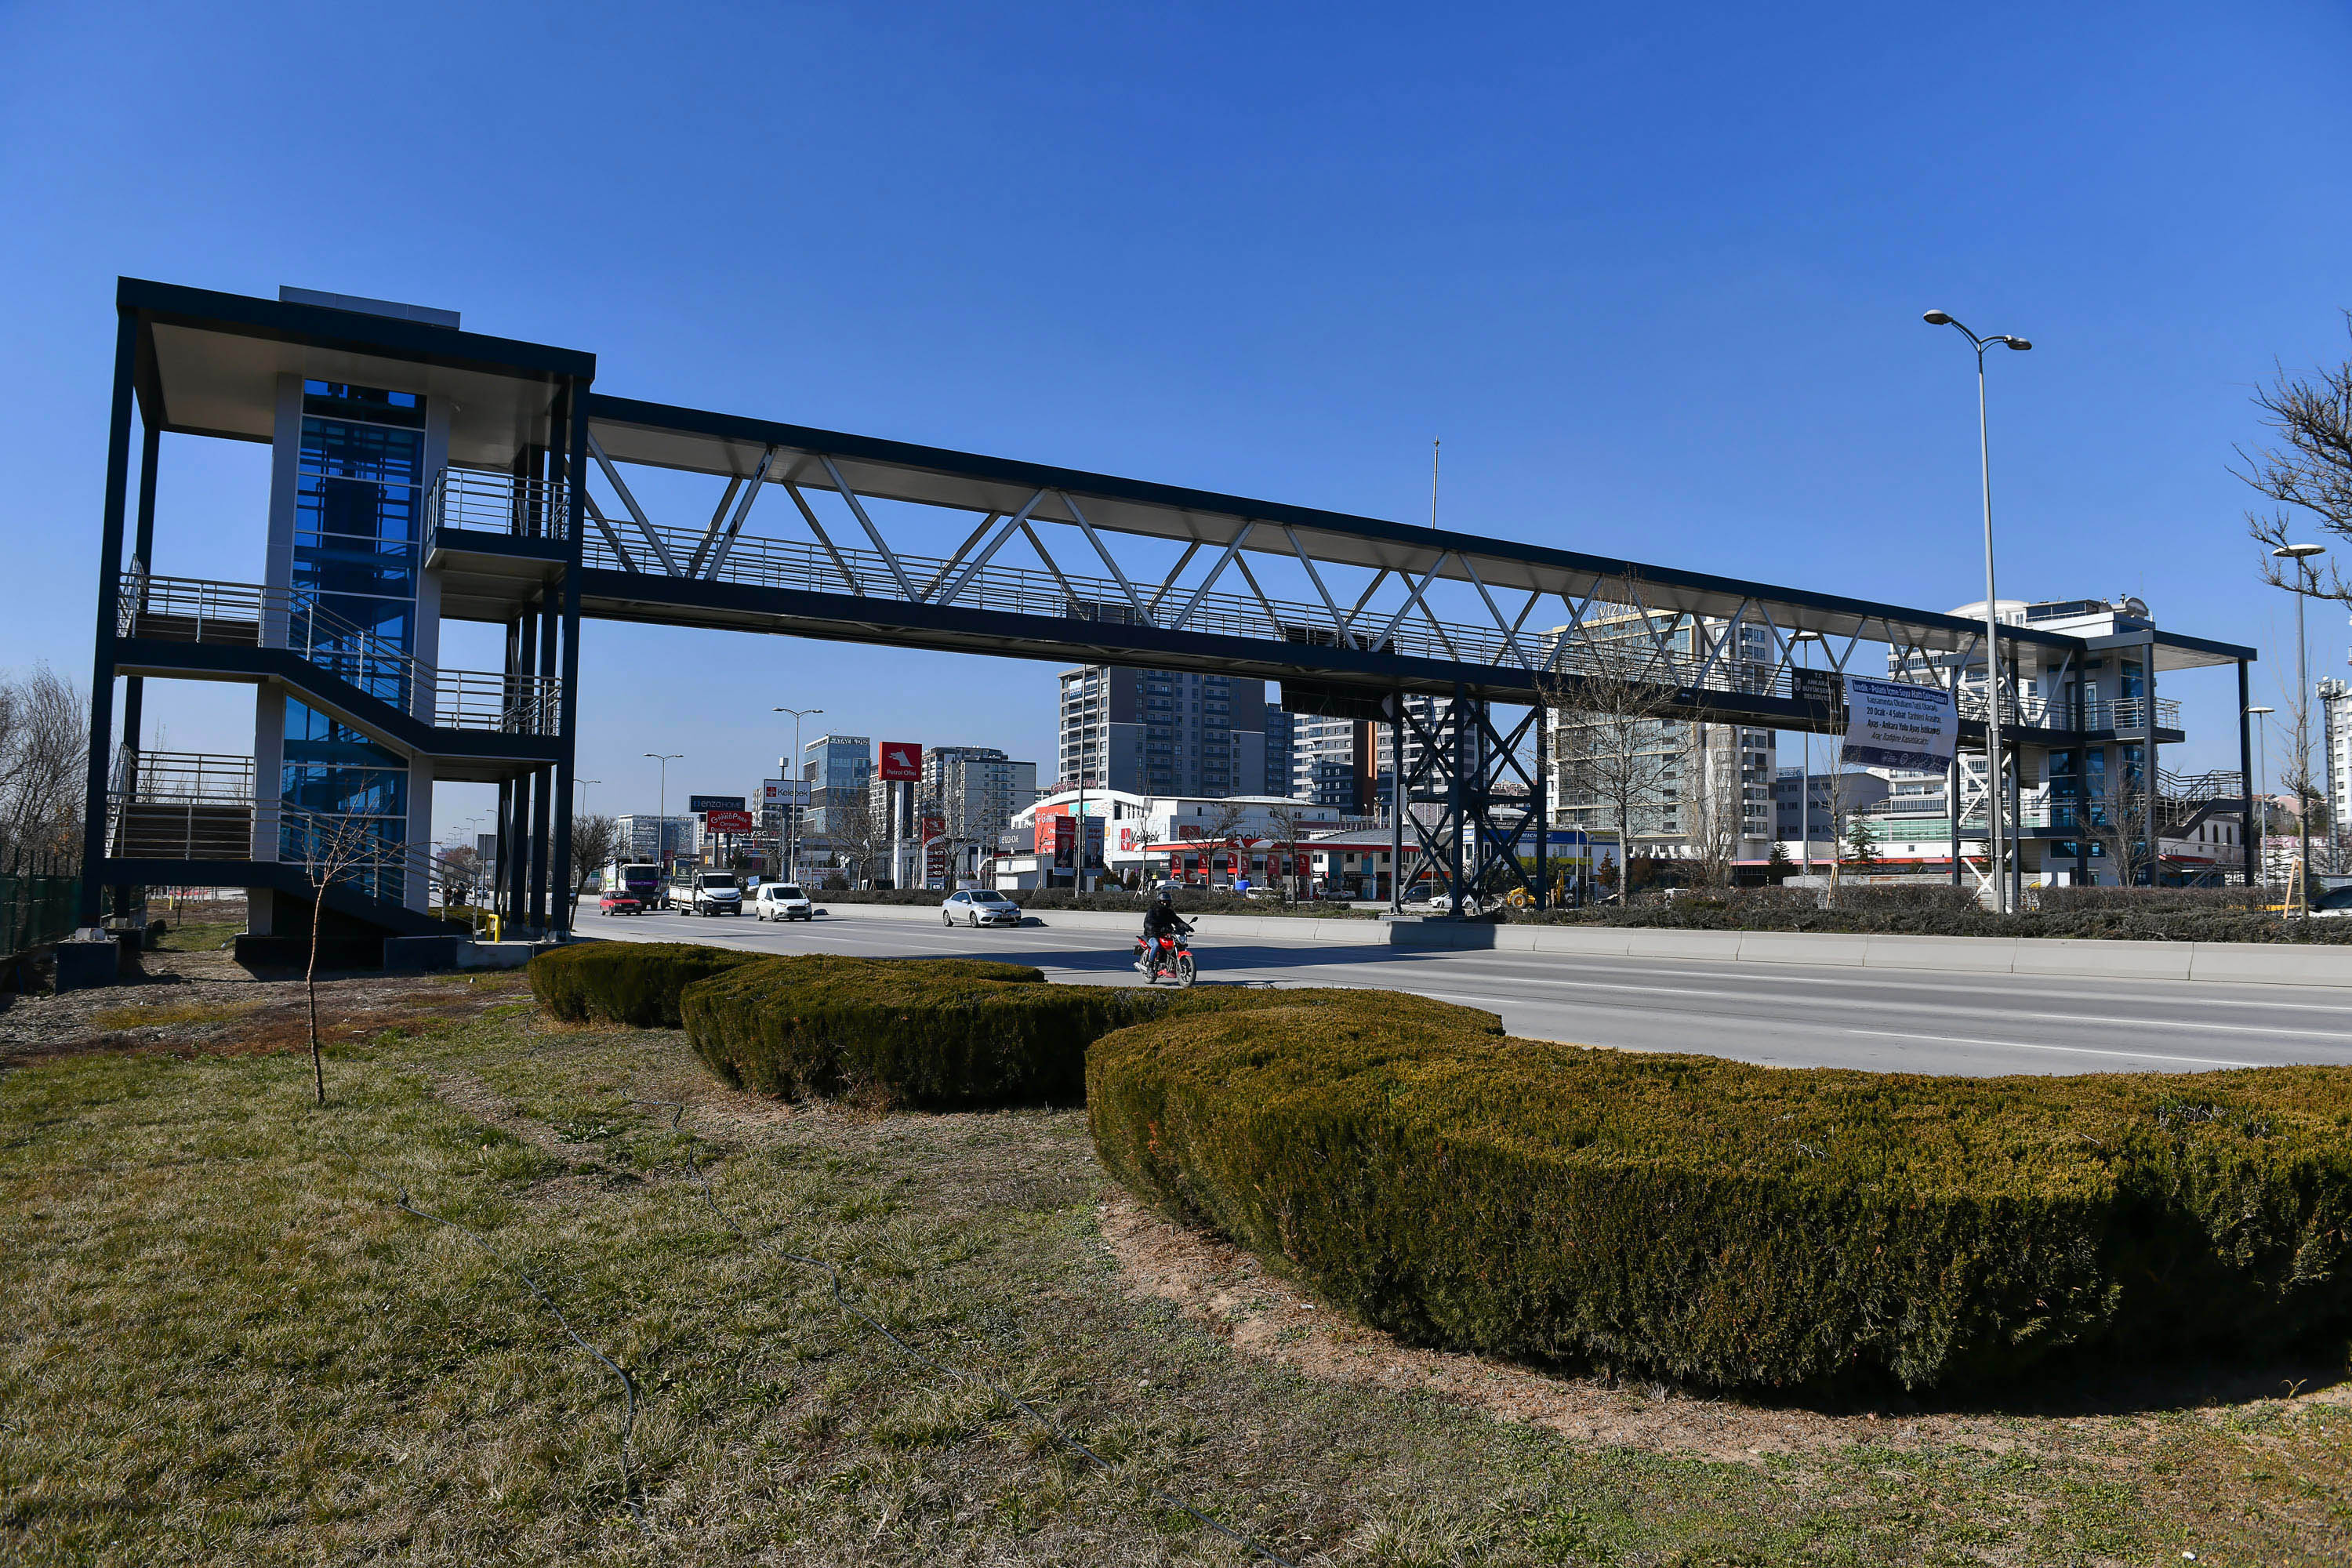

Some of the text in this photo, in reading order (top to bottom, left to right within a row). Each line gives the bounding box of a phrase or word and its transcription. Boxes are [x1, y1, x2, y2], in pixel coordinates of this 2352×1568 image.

[1867, 706, 1874, 715] 20
[1874, 707, 1886, 716] Ocak
[1893, 710, 1906, 719] Şubat
[1867, 719, 1878, 729] Ayaş
[1882, 720, 1898, 731] Ankara
[1898, 723, 1909, 731] Yolu
[1909, 724, 1920, 734] Ayaş
[778, 788, 808, 797] Kelebek
